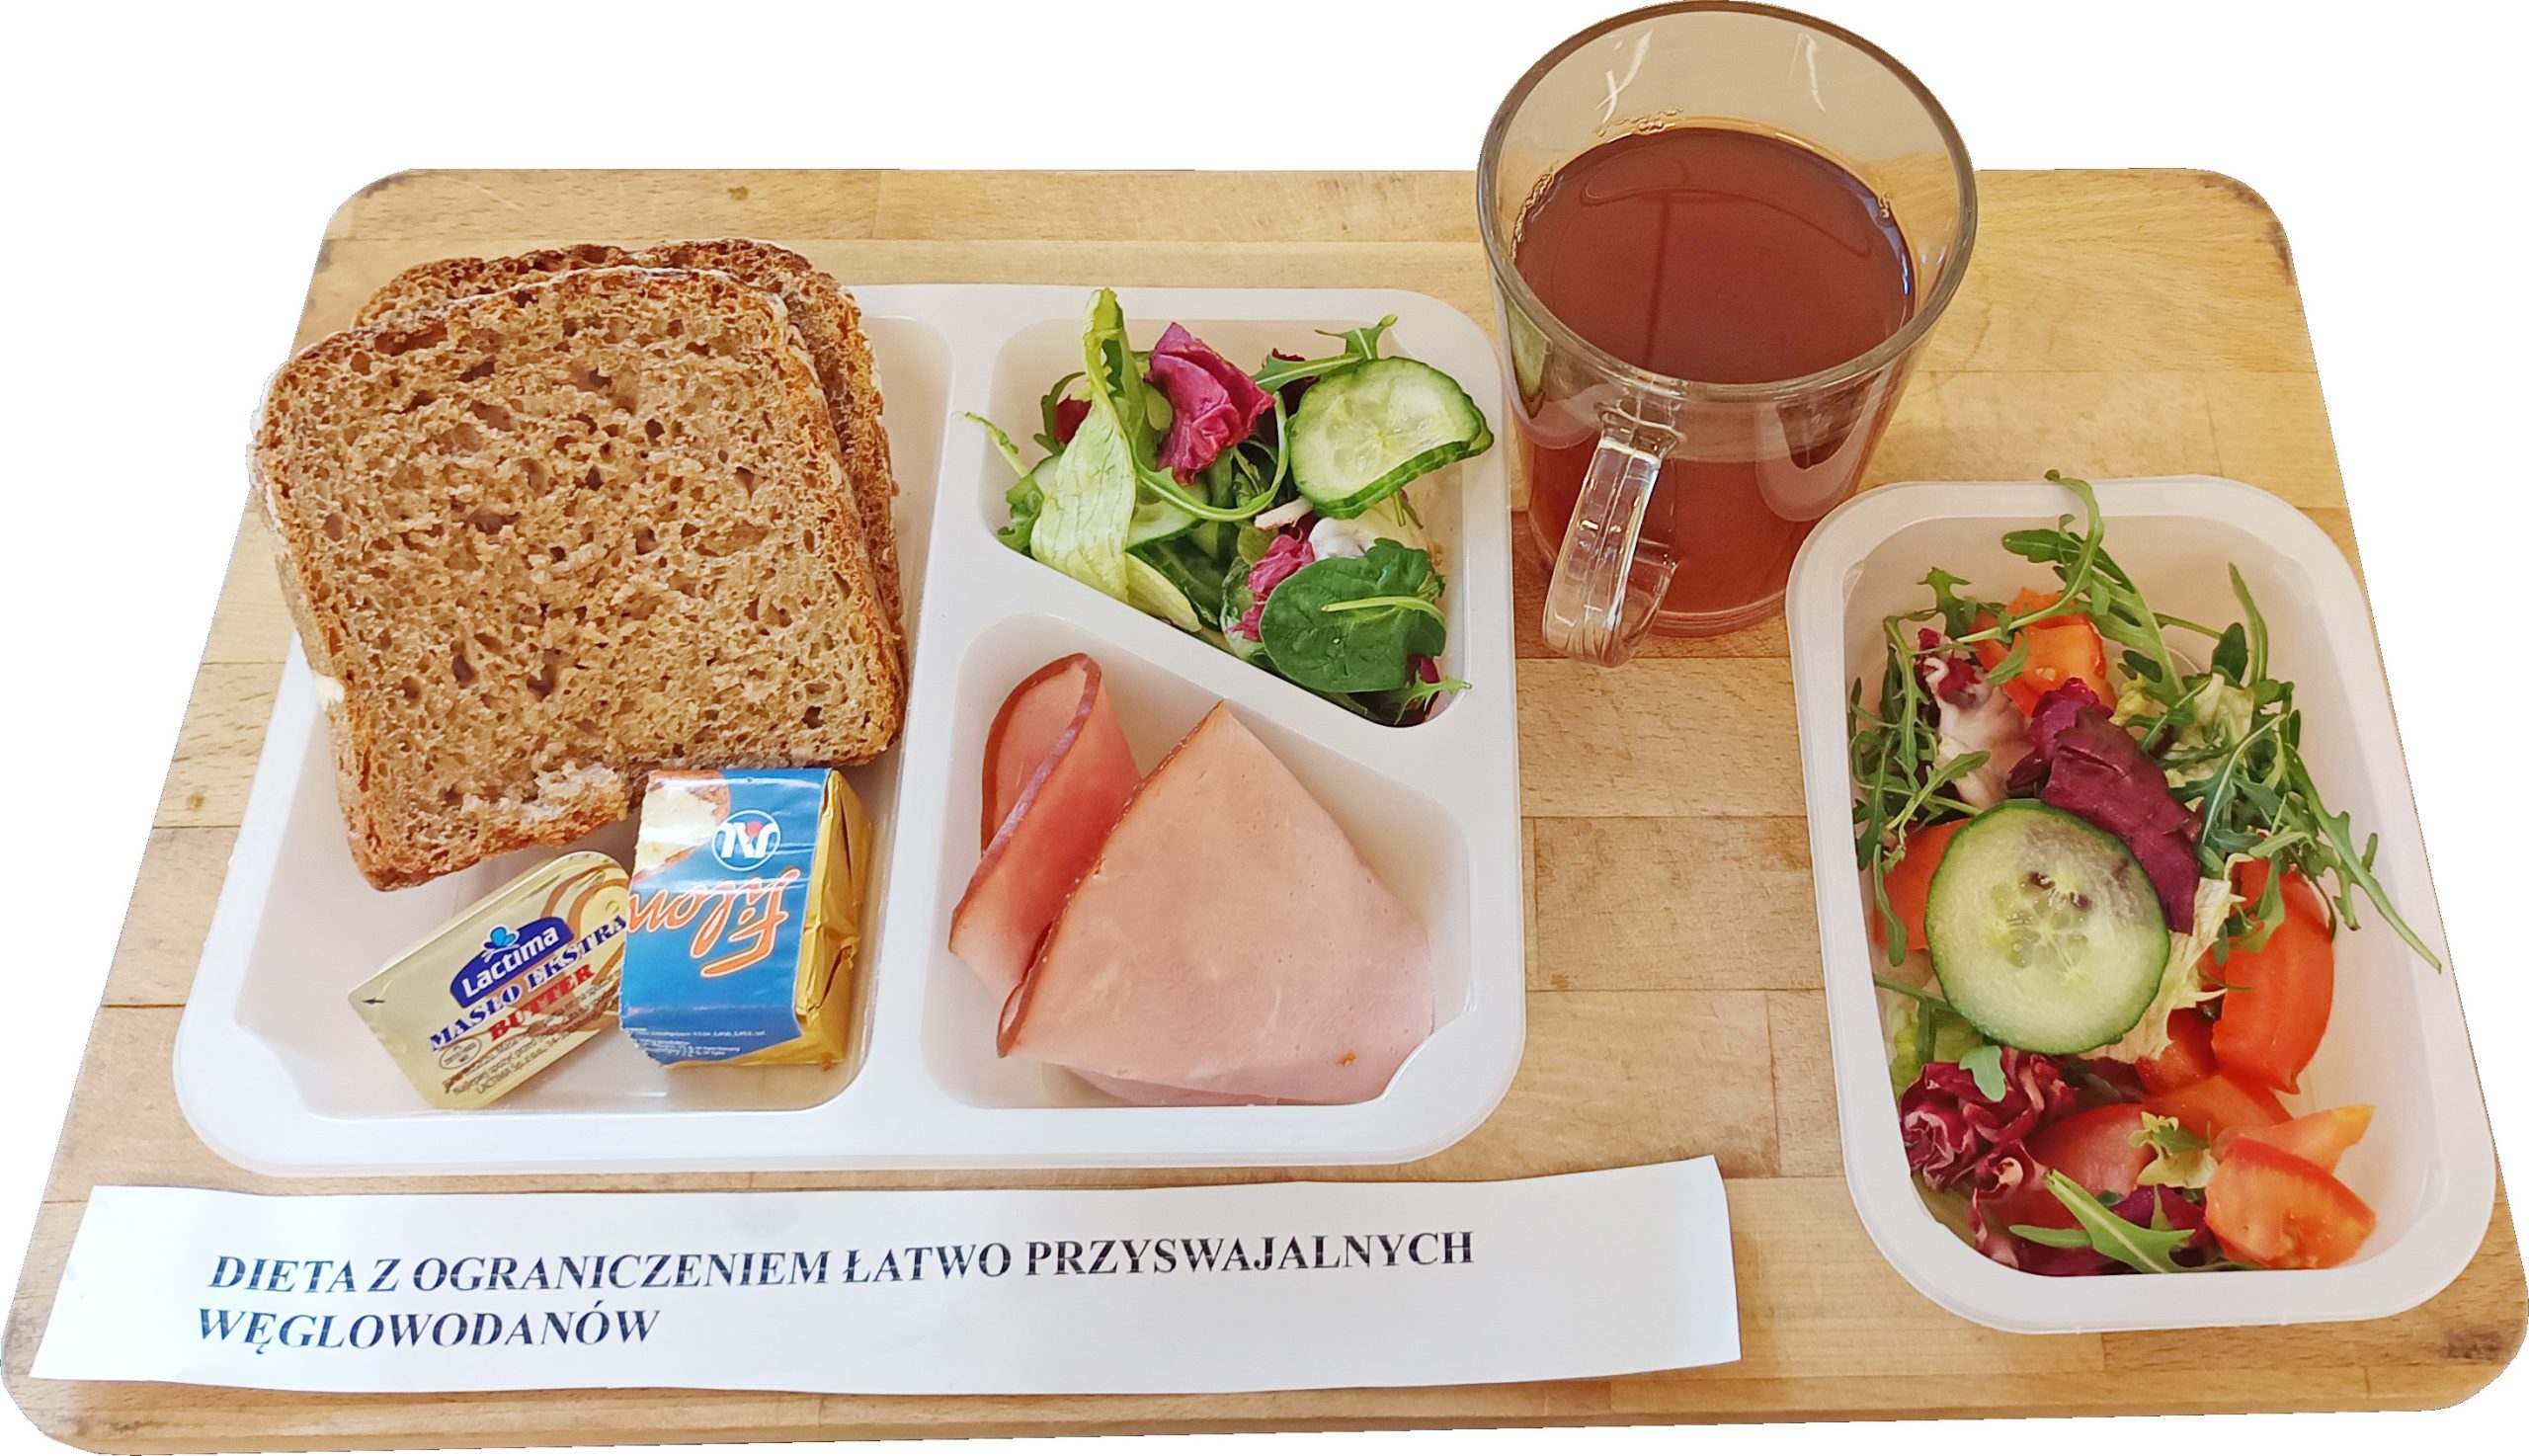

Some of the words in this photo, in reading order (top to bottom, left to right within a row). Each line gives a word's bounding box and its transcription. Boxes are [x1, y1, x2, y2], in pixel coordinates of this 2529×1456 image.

[429, 984, 523, 1052] MASŁO
[525, 915, 627, 992] EKSTRA
[460, 925, 559, 1000] Lactima
[488, 962, 595, 1042] BUTTER
[208, 1254, 357, 1293] DIETA
[367, 1258, 401, 1292] Z
[413, 1251, 831, 1292] OGRANICZENIEM
[842, 1242, 1012, 1284] ŁATWO
[1024, 1231, 1476, 1276] PRZYSWAJALNYCH
[198, 1300, 660, 1354] WĘGLOWODANÓW
